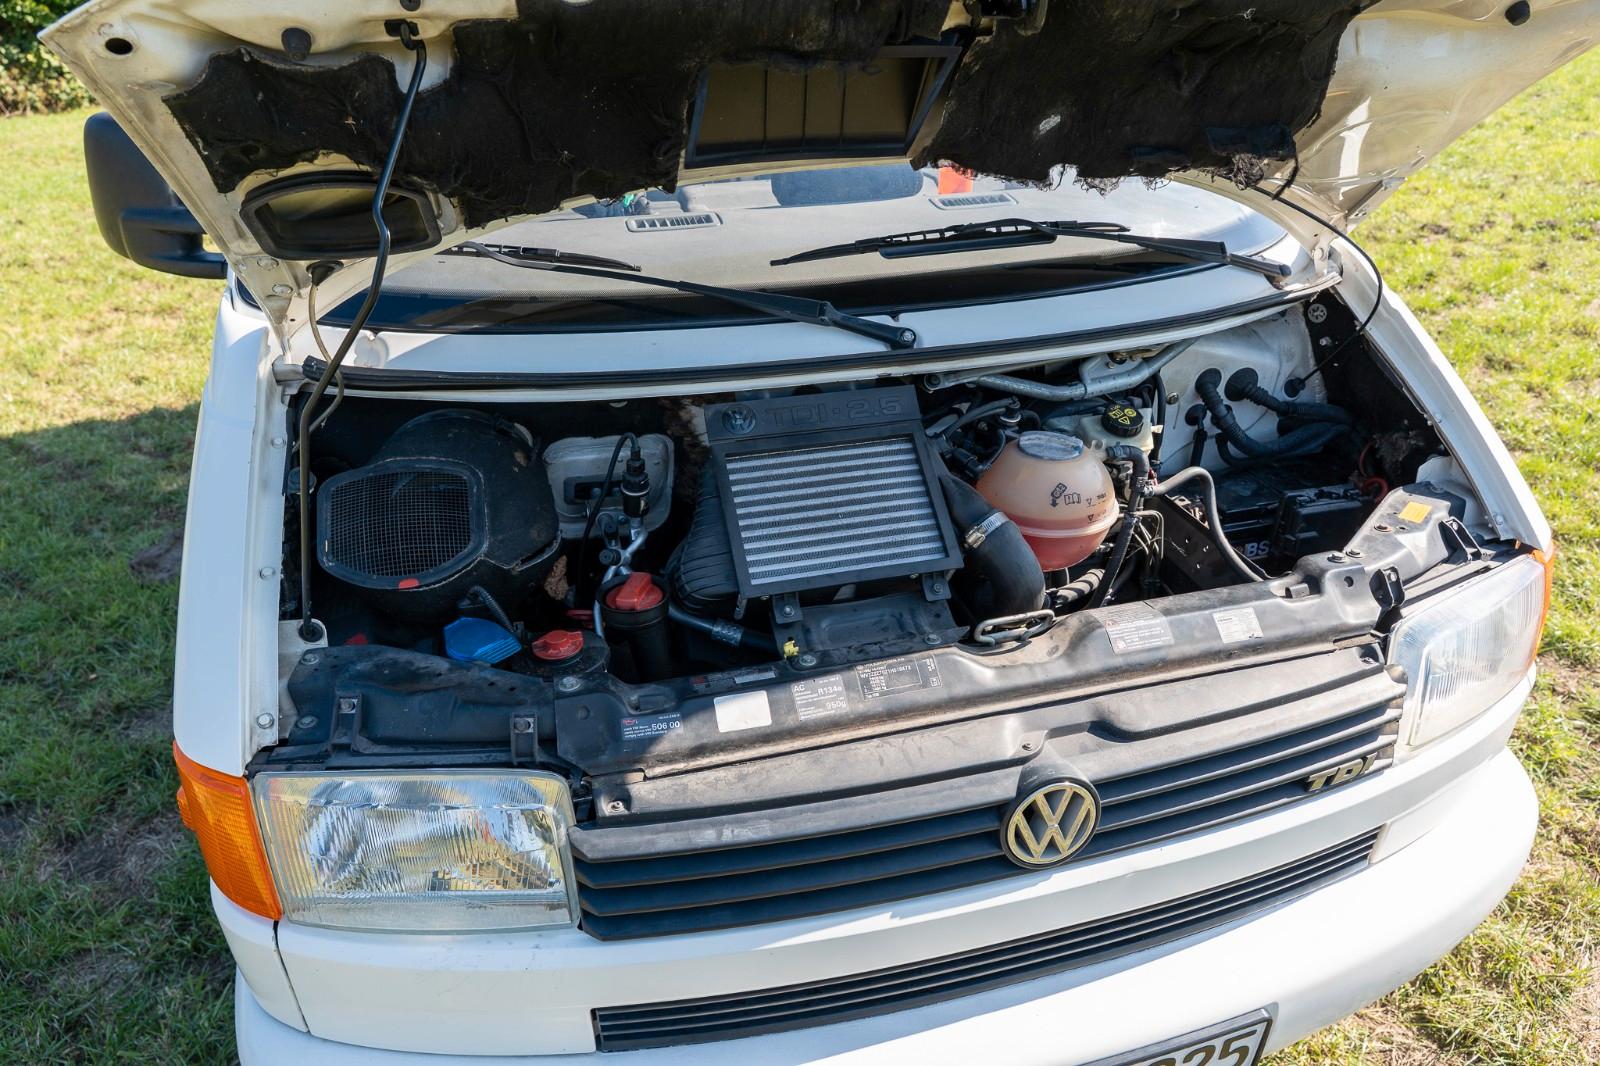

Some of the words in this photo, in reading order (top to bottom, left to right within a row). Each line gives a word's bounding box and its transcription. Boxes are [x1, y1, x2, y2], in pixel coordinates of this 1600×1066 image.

[794, 683, 805, 693] AC
[651, 722, 668, 731] 506
[669, 720, 681, 729] 00
[1307, 751, 1378, 793] TDI
[1008, 783, 1096, 863] VW
[1150, 1029, 1258, 1066] 25
